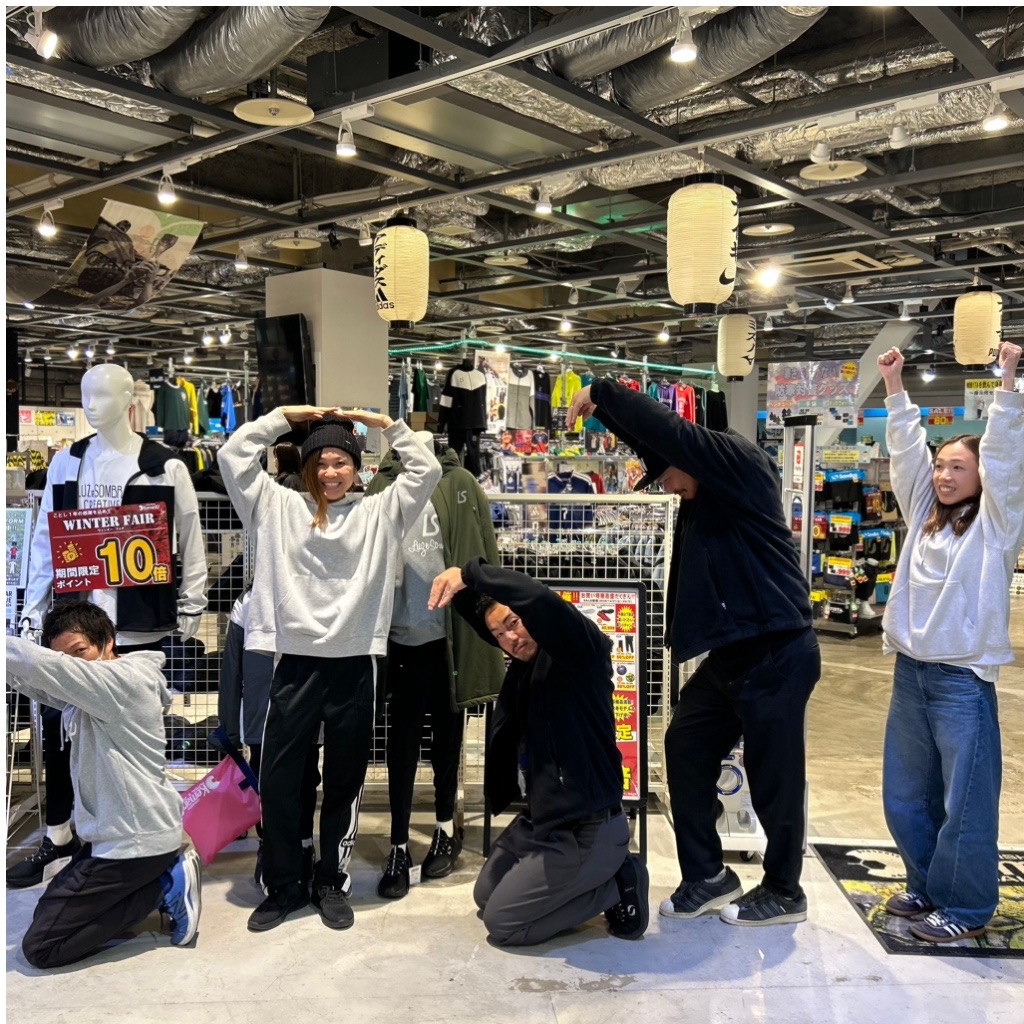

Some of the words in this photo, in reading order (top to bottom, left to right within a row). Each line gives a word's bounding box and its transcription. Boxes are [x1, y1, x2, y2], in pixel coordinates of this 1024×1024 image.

[457, 490, 467, 504] LS
[63, 517, 120, 531] WINTER
[123, 513, 155, 525] FAIR
[422, 514, 439, 537] LS
[97, 536, 156, 585] 10
[55, 565, 100, 578] 期間限定
[152, 565, 168, 582] 倍
[56, 579, 91, 589] ポイント
[616, 724, 633, 740] 定
